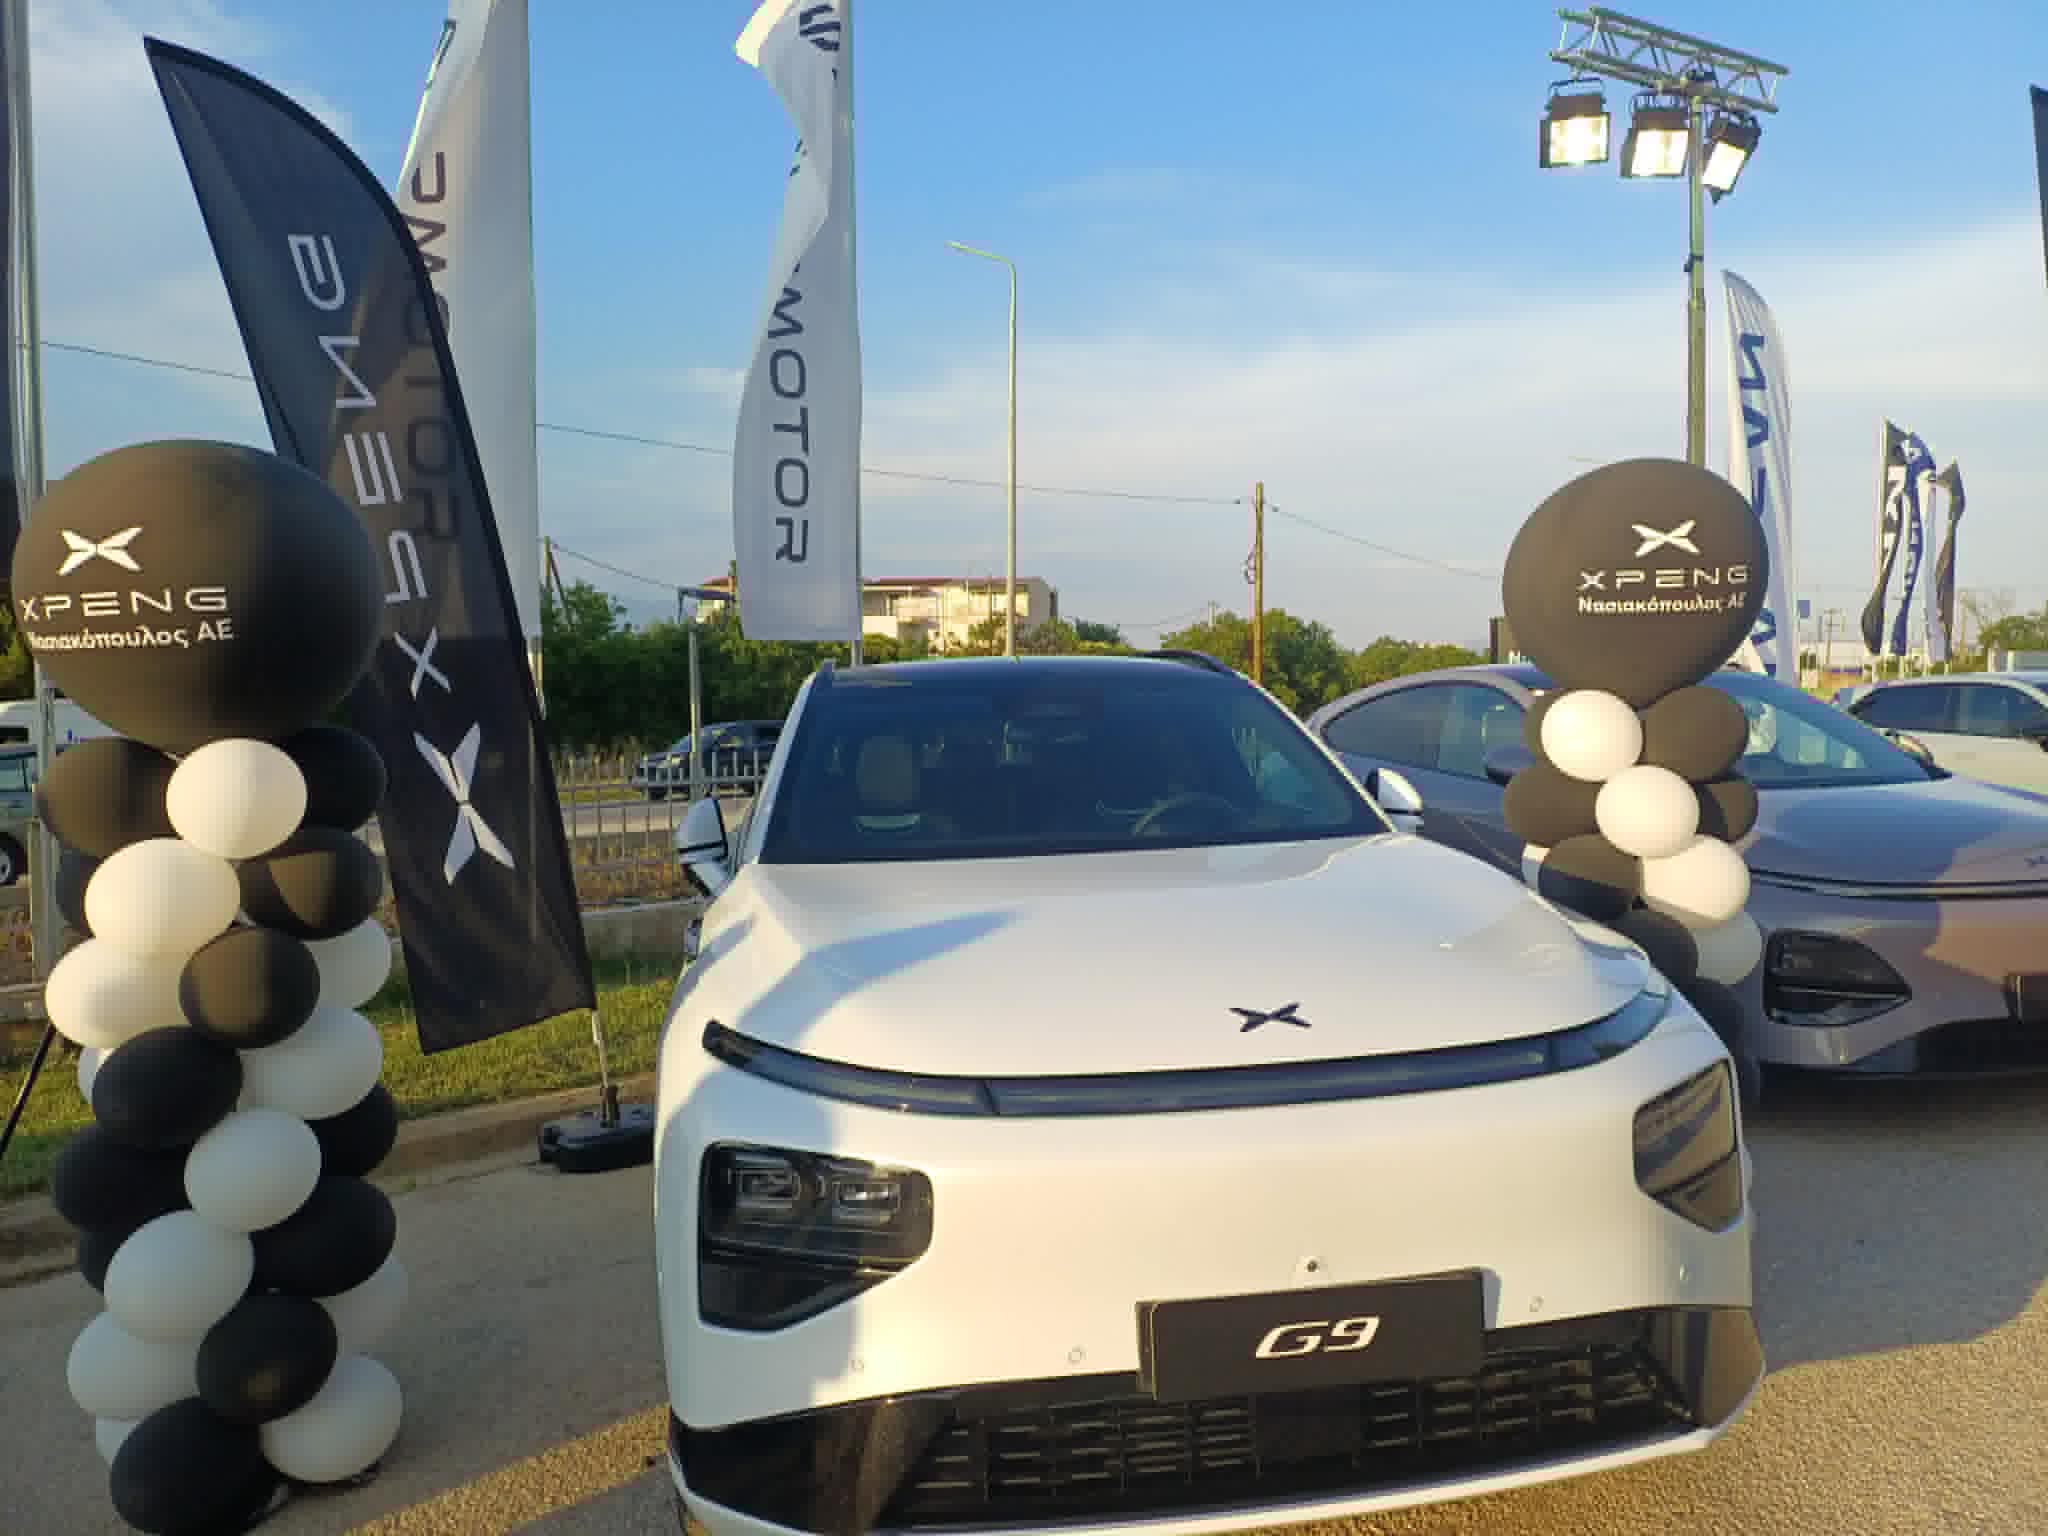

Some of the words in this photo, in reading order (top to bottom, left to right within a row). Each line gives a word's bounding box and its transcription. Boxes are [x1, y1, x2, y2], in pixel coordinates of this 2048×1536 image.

[767, 263, 810, 563] MOTOR
[1577, 564, 1749, 592] XPENG
[19, 586, 230, 622] XPENG
[1255, 1314, 1381, 1360] G9
